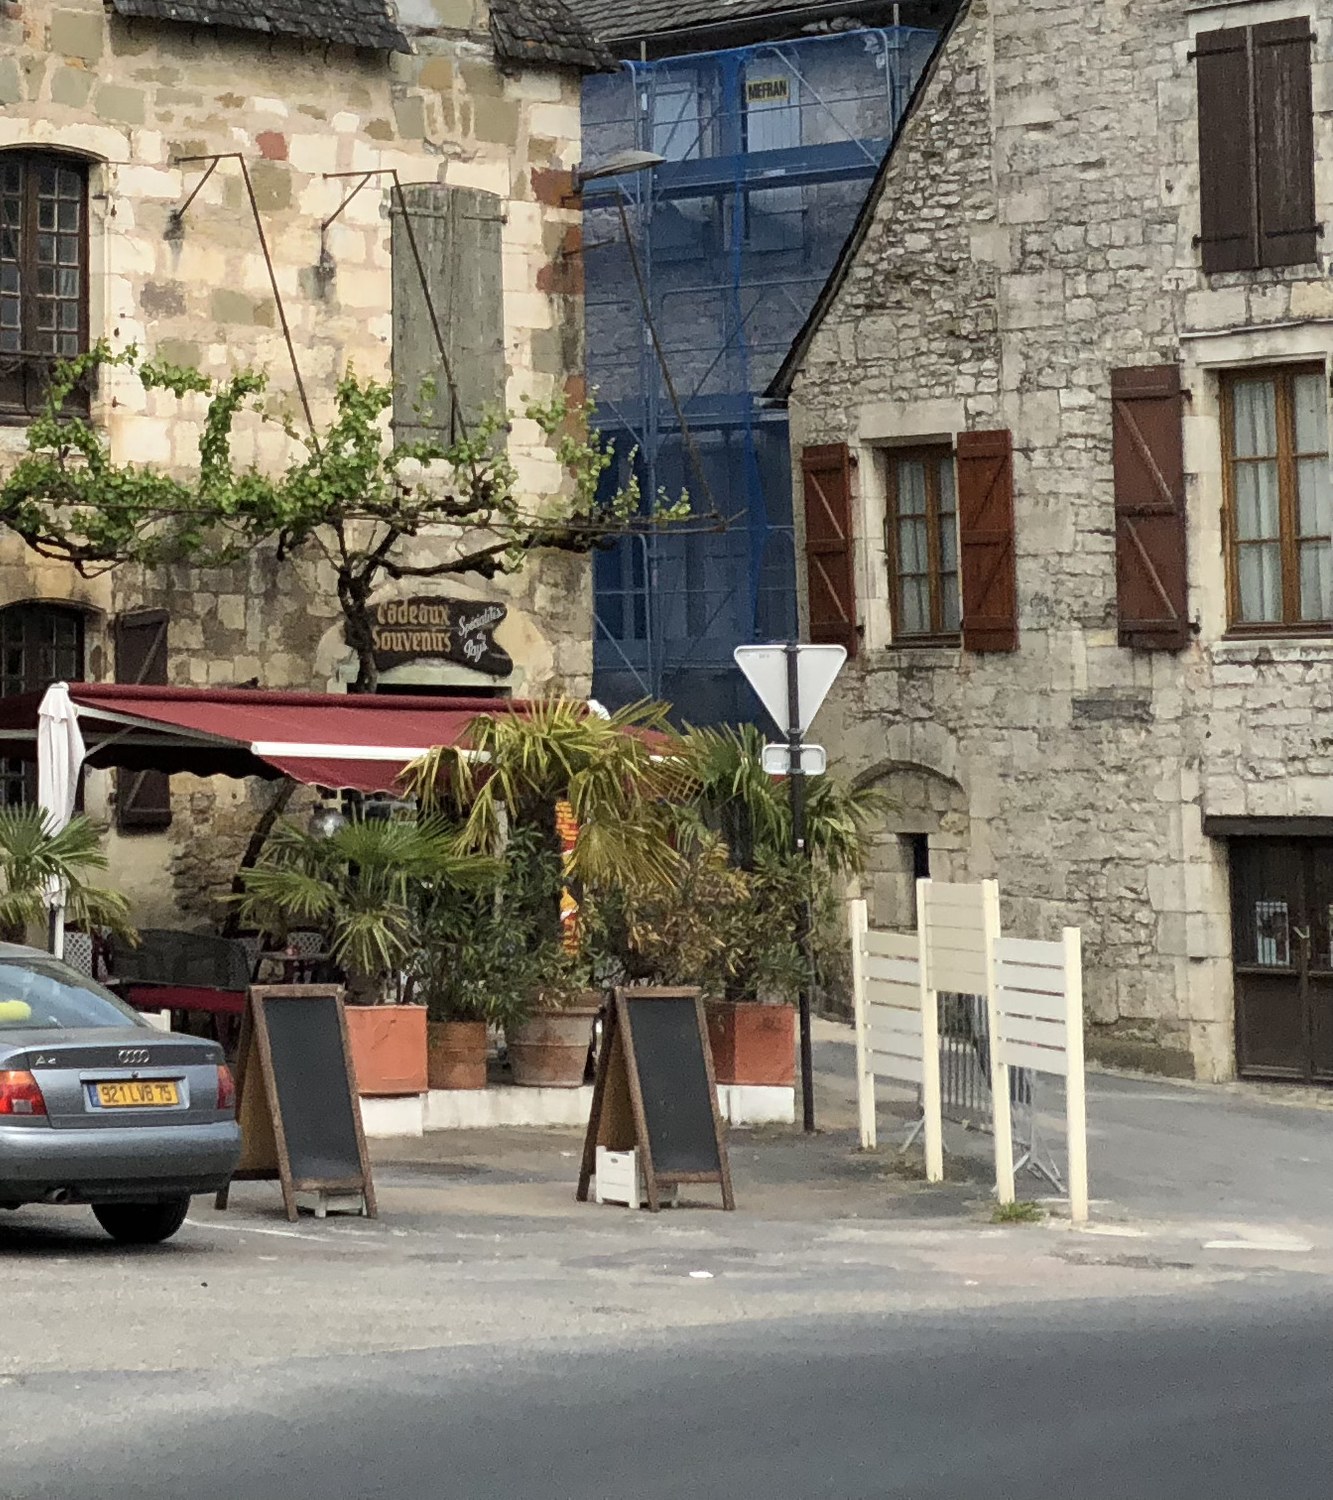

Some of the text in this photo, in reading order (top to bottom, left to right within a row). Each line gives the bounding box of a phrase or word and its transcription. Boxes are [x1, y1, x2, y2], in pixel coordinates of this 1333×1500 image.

[377, 600, 451, 626] Cadeaux
[372, 627, 452, 653] Souvenirs
[101, 1084, 127, 1103] 921
[154, 1083, 173, 1102] 75
